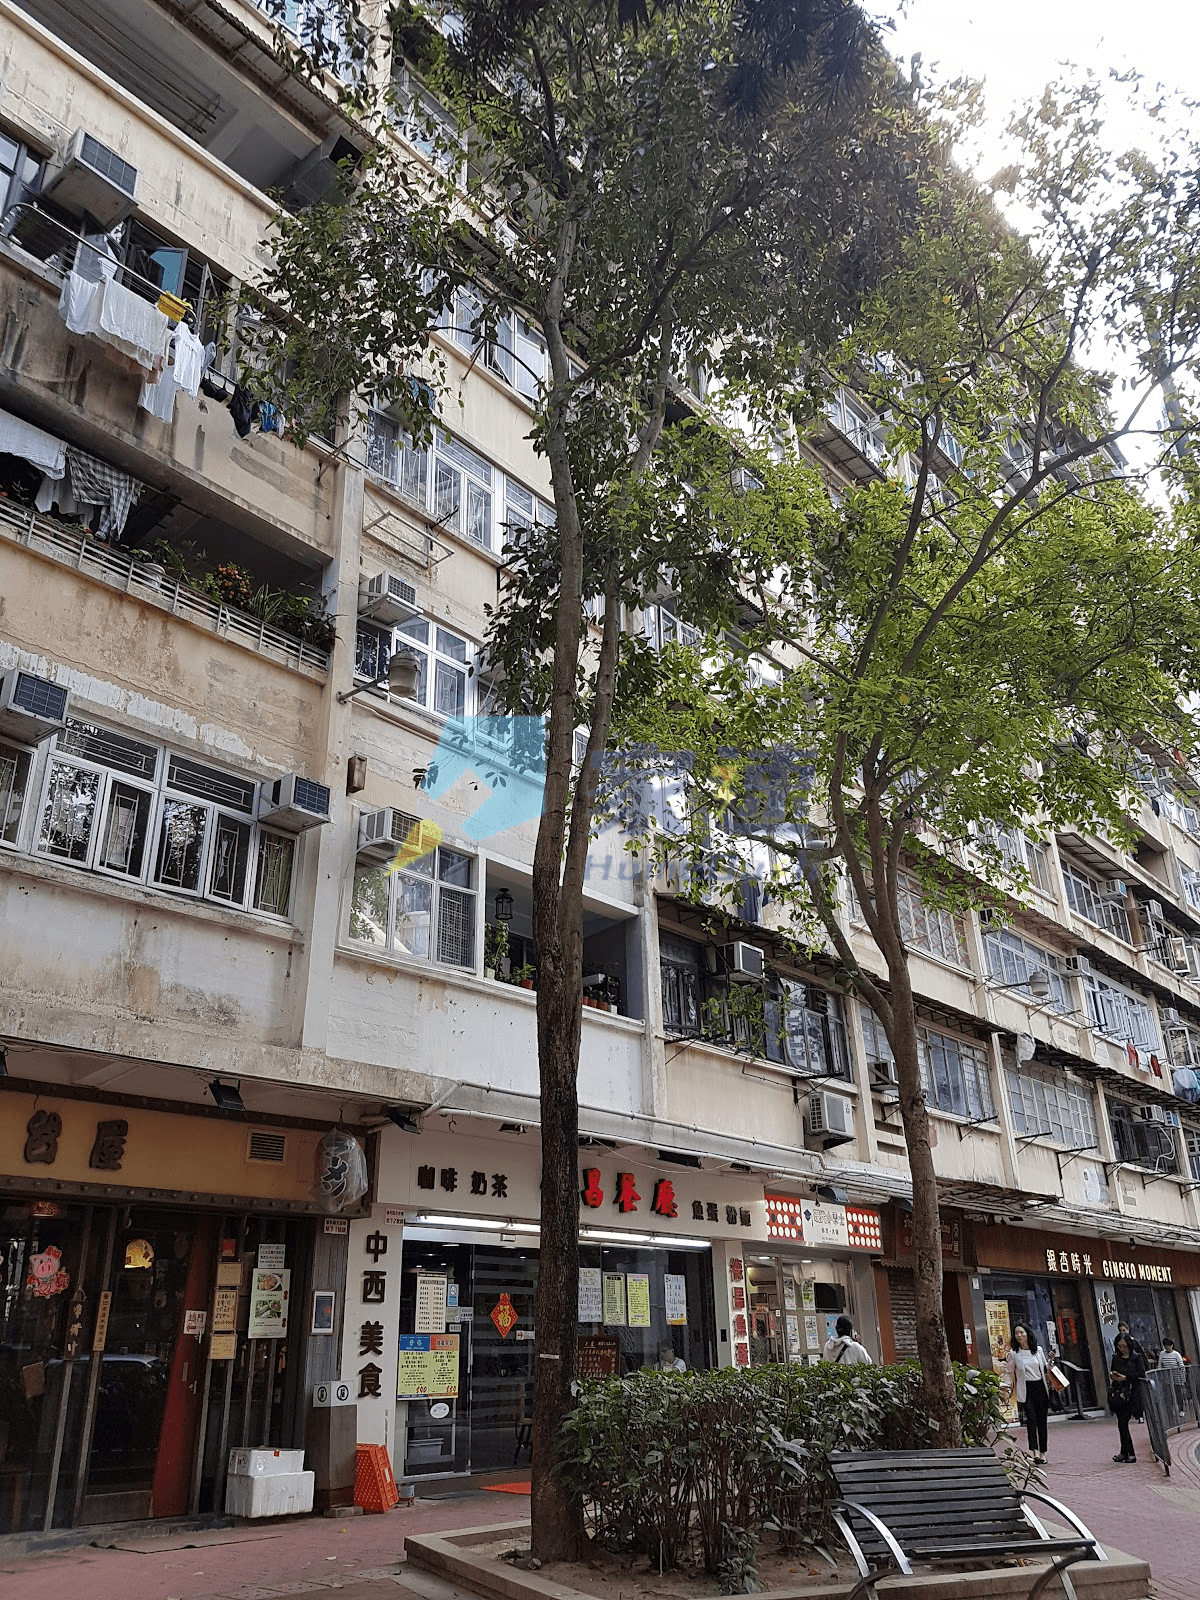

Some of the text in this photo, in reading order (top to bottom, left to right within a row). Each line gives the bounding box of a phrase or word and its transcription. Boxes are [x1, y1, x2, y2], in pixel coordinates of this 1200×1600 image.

[581, 1167, 679, 1218] 昌餐廳
[1046, 1249, 1093, 1275] 銀杏時光
[1102, 1259, 1172, 1283] GINGKO MOMENT
[357, 1230, 389, 1398] 中西美食
